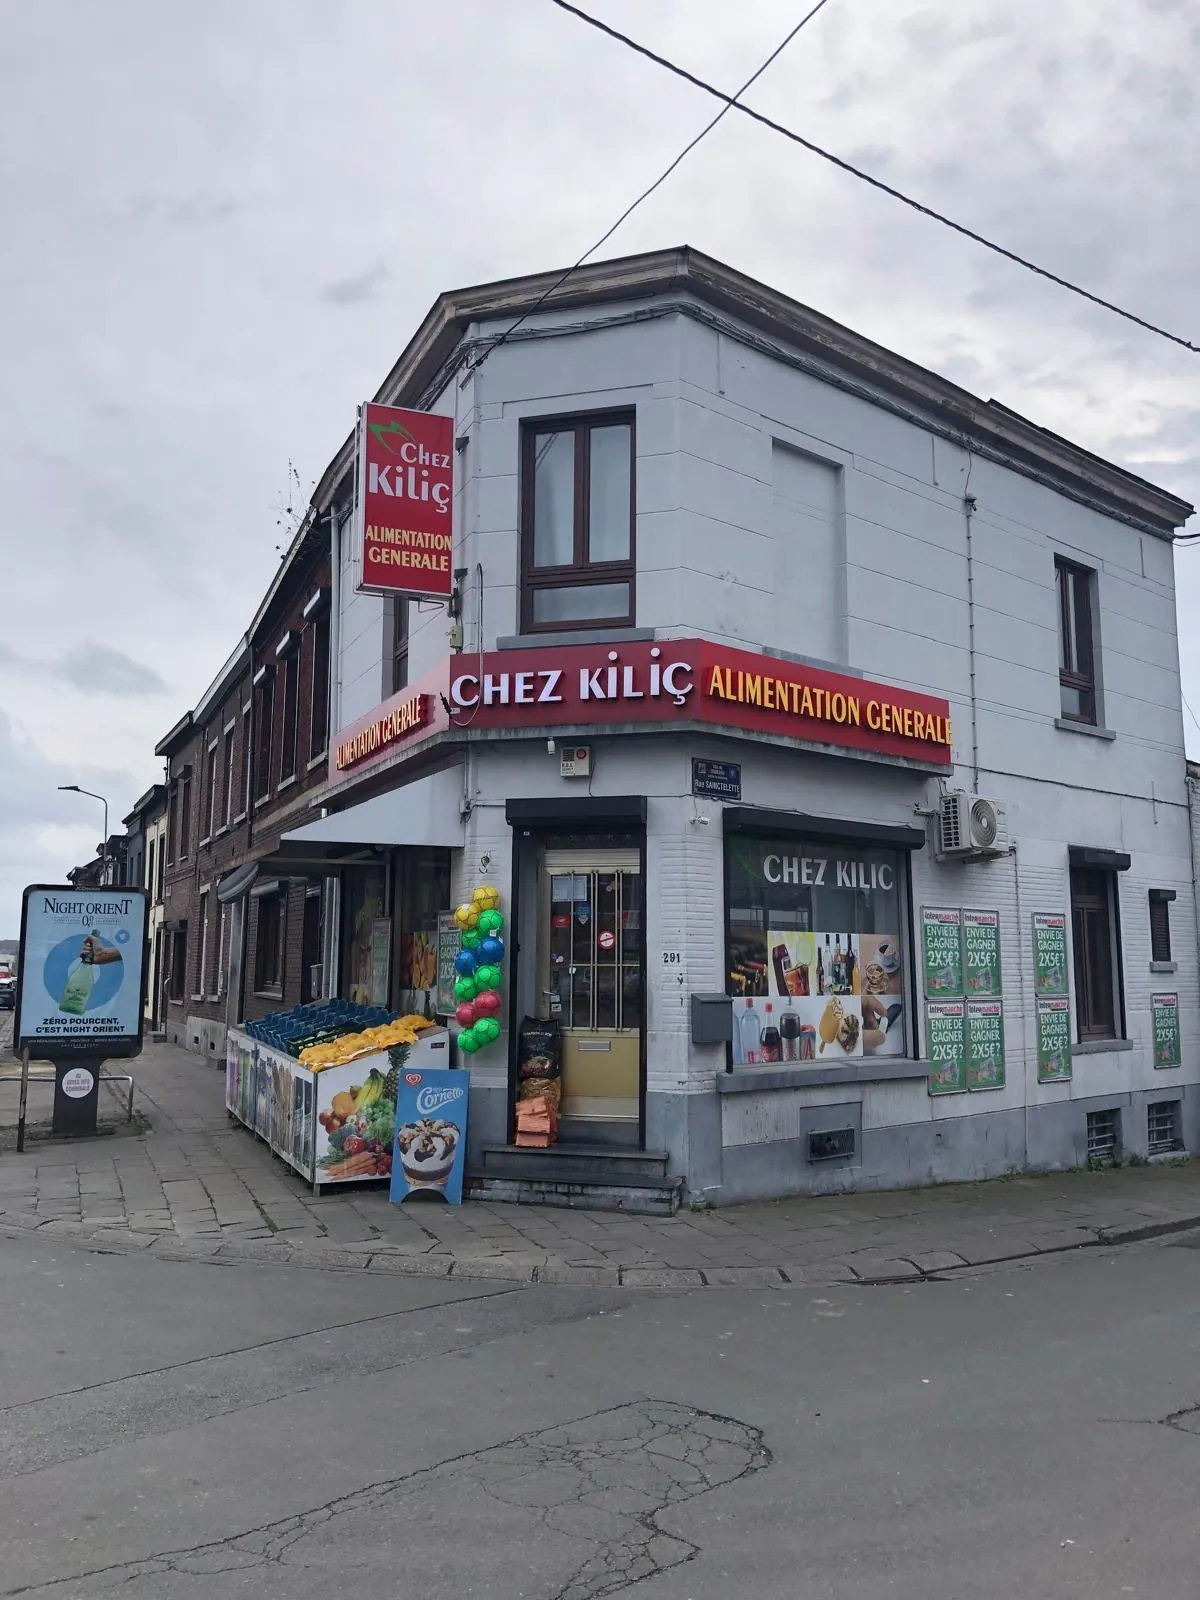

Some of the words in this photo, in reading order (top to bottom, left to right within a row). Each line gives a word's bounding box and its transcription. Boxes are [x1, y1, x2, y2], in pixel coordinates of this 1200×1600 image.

[368, 462, 450, 514] Kiliç
[365, 524, 453, 552] ALIMENTATION
[368, 546, 449, 572] GENERALE
[451, 670, 563, 706] CHEZ
[709, 665, 861, 726] ALIMENTATION
[866, 700, 953, 745] GENERALE
[336, 721, 381, 770] ALIMENTATION
[382, 694, 421, 743] GENERALE
[763, 854, 828, 886] CHEZ
[836, 860, 894, 890] KILIC
[43, 897, 84, 914] NIGHT
[86, 899, 132, 915] ORIENT
[926, 926, 948, 937] ENVIE
[949, 926, 959, 937] DE
[966, 927, 986, 938] ENVIE
[987, 928, 996, 938] DE
[1037, 930, 1055, 940] ENVIE
[1056, 930, 1064, 940] DE
[927, 937, 959, 949] GAGNER
[966, 940, 996, 950] GAGNER
[1038, 940, 1064, 951] GAGNER
[663, 952, 681, 963] 291
[43, 1017, 67, 1025] ZÉRO
[970, 1019, 990, 1029] ENVIE
[991, 1018, 1000, 1029] DE
[1040, 1014, 1058, 1024] ENVIE
[1059, 1013, 1067, 1023] DE
[36, 1026, 61, 1034] C'EST
[92, 1025, 125, 1033] ORIENT
[931, 1019, 953, 1030] ENVIE
[953, 1019, 963, 1030] DE
[1041, 1024, 1068, 1035] GAGNER
[931, 1030, 963, 1042] GAGNER
[970, 1030, 1000, 1041] GAGNER
[416, 1086, 464, 1114] Cornetto
